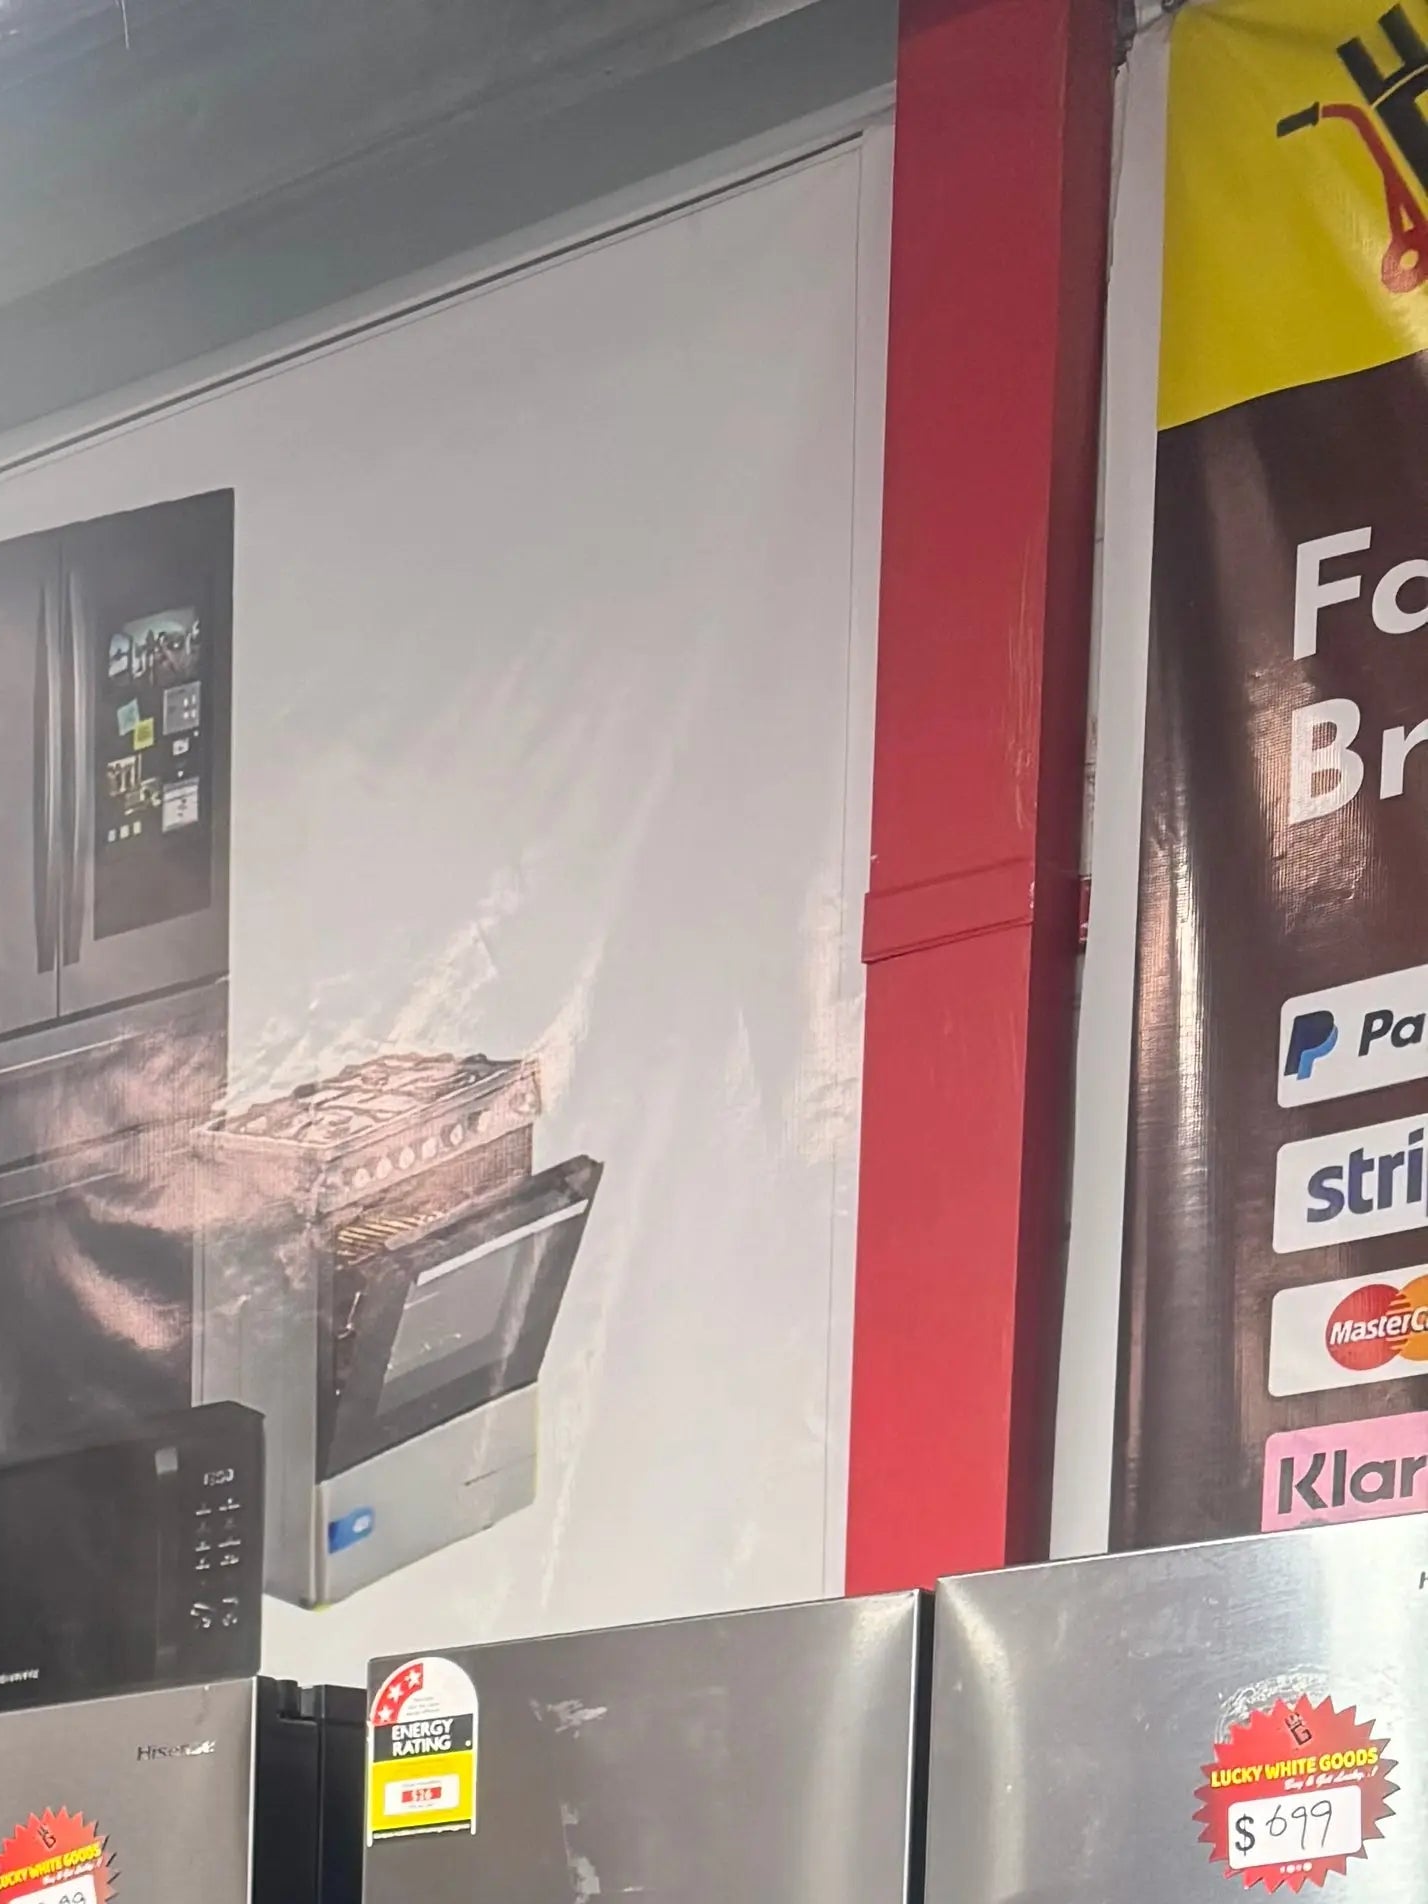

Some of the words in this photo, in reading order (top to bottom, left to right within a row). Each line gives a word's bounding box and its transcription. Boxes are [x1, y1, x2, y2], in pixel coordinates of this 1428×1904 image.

[1288, 699, 1428, 825] Br
[1358, 1009, 1426, 1056] Pa
[1307, 1127, 1428, 1223] stri
[1330, 1306, 1428, 1345] MasterC
[1277, 1449, 1428, 1514] Klar
[391, 1719, 454, 1741] ENERGY
[393, 1735, 452, 1757] RATING
[136, 1741, 214, 1761] Hise
[1210, 1765, 1263, 1788] LUCKY
[1264, 1756, 1318, 1779] WHITE
[1318, 1746, 1379, 1771] GOODS
[28, 1855, 63, 1879] WHITE
[63, 1841, 103, 1867] GOODS
